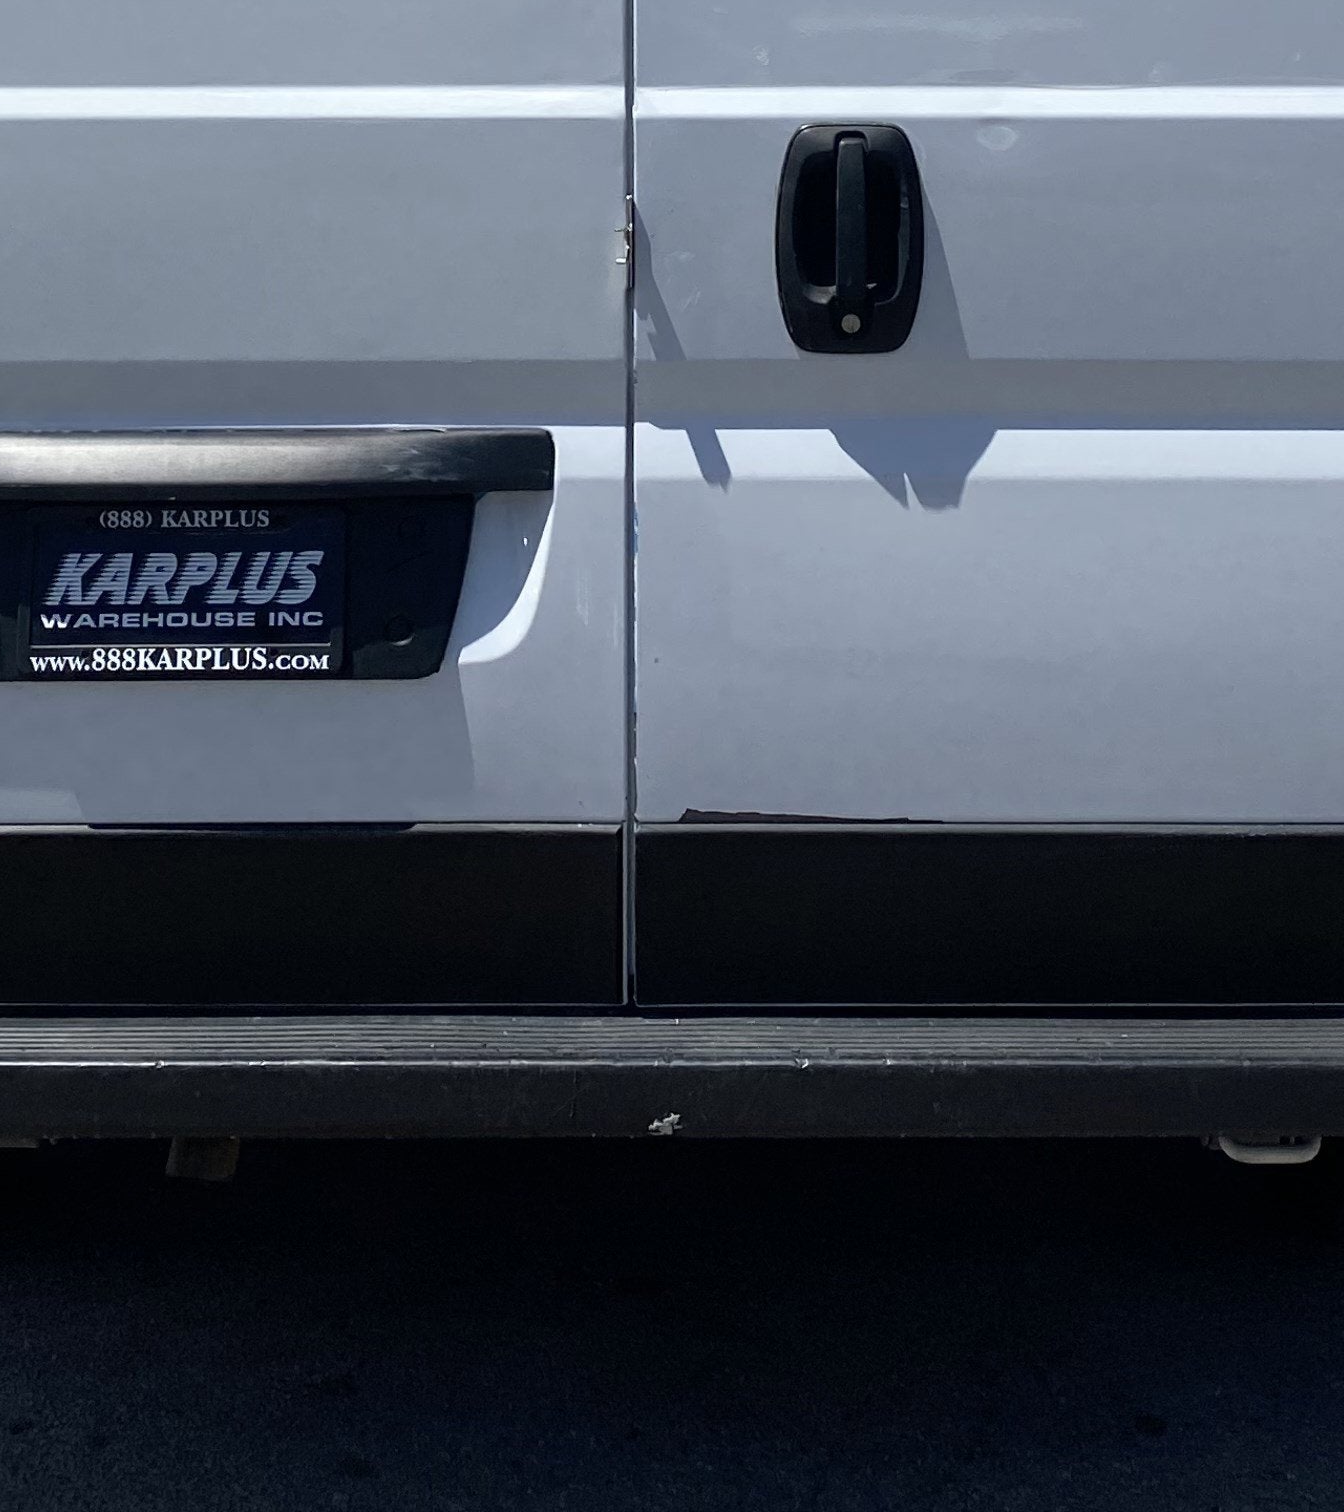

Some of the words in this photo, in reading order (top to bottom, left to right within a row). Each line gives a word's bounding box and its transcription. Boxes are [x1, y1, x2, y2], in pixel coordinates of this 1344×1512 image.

[99, 509, 153, 529] (888)
[160, 509, 271, 528] KARPLUS
[42, 550, 324, 605] KARPLUS
[40, 611, 256, 629] WAREHOUSE
[268, 610, 324, 627] INC
